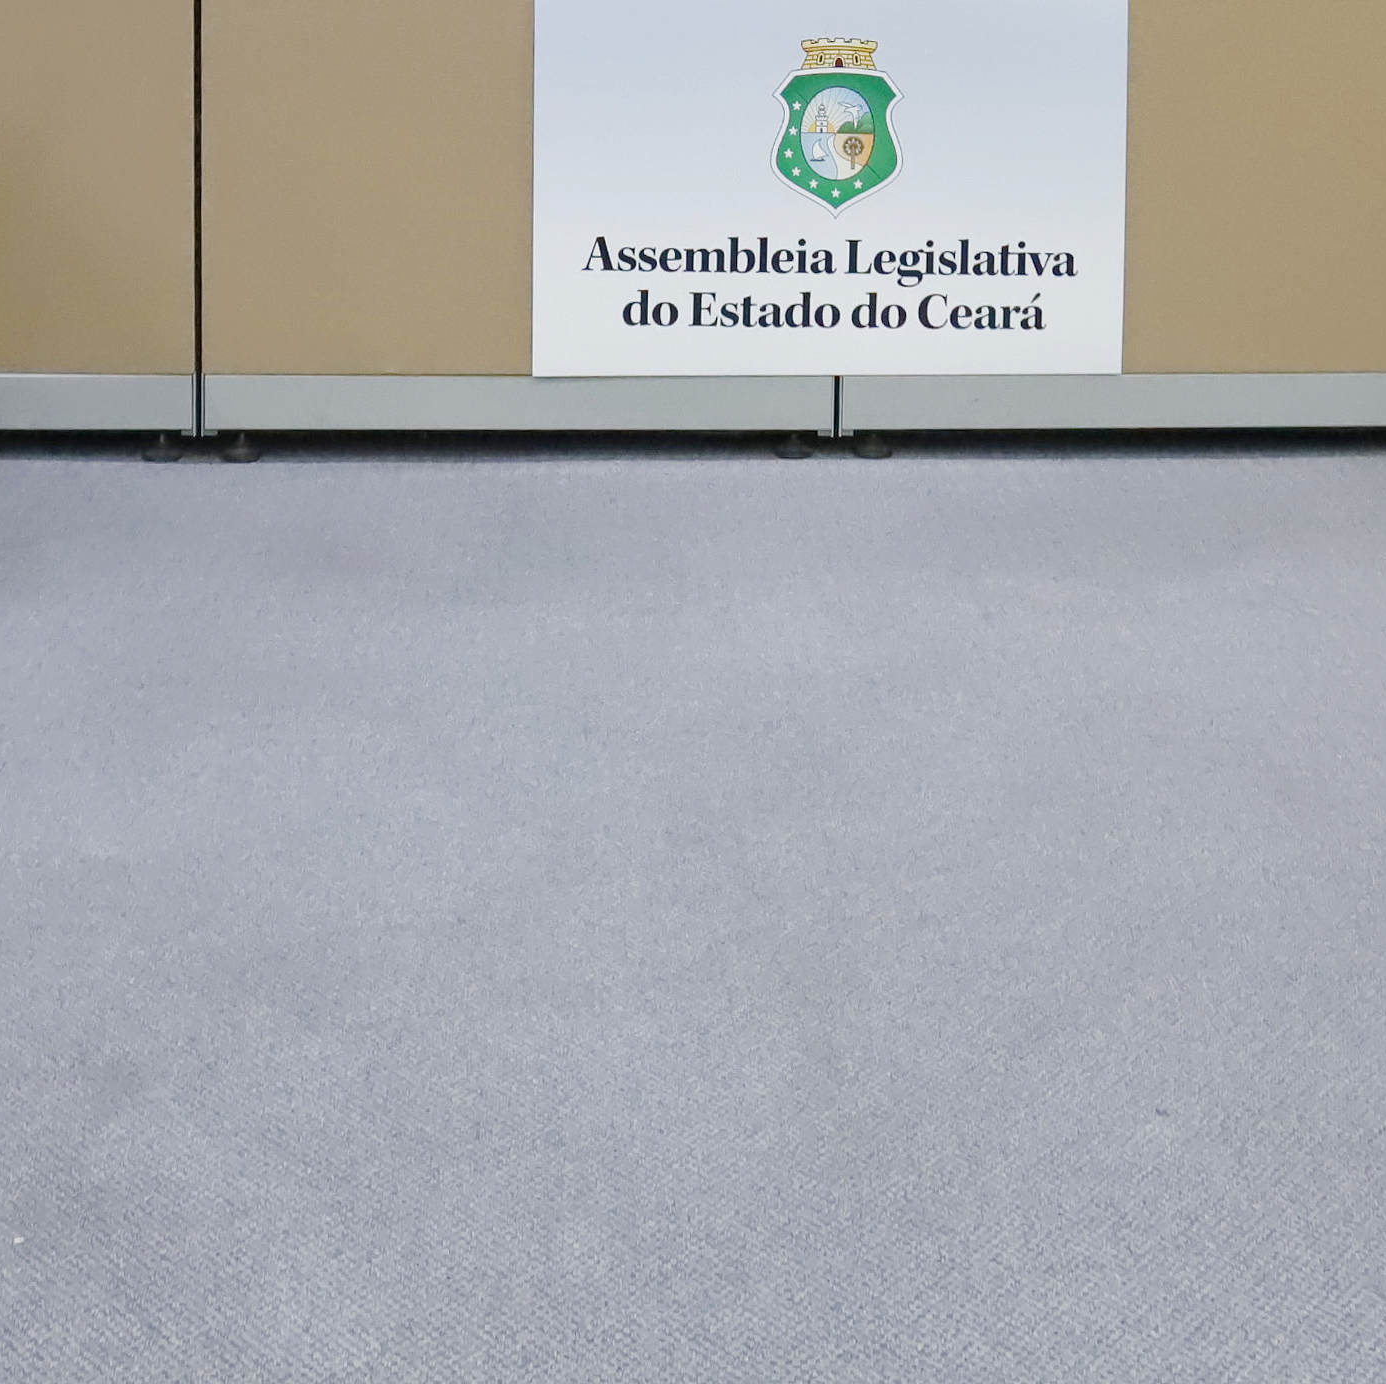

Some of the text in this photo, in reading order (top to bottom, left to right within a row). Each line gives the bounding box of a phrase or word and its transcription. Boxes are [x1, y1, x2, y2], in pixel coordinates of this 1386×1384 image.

[581, 236, 1078, 288] Assembleia Legislativa
[622, 289, 1047, 330] do Estado do Ceará
